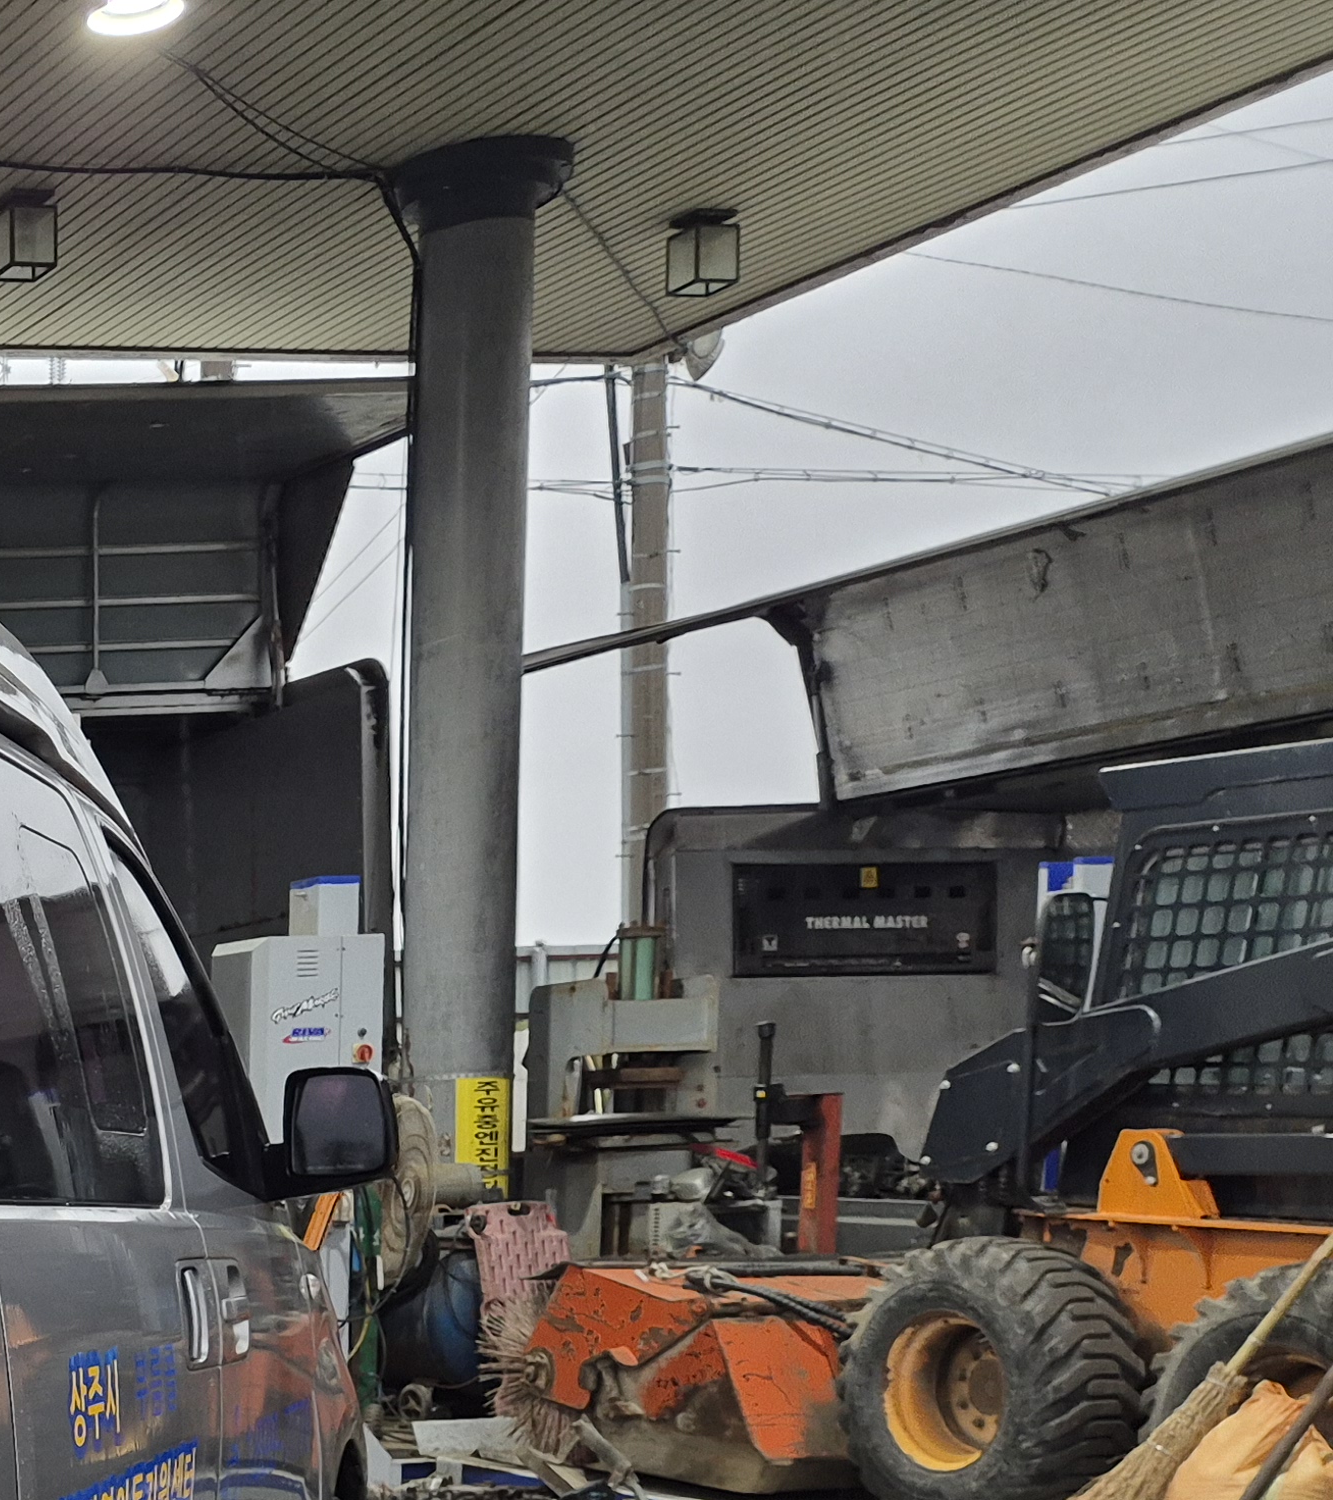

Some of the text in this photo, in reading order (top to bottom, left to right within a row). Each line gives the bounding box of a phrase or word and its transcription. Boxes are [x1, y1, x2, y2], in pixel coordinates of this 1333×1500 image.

[805, 915, 870, 930] THERMAL
[473, 1079, 500, 1190] 주유중엔진
[69, 1357, 120, 1448] 상주시
